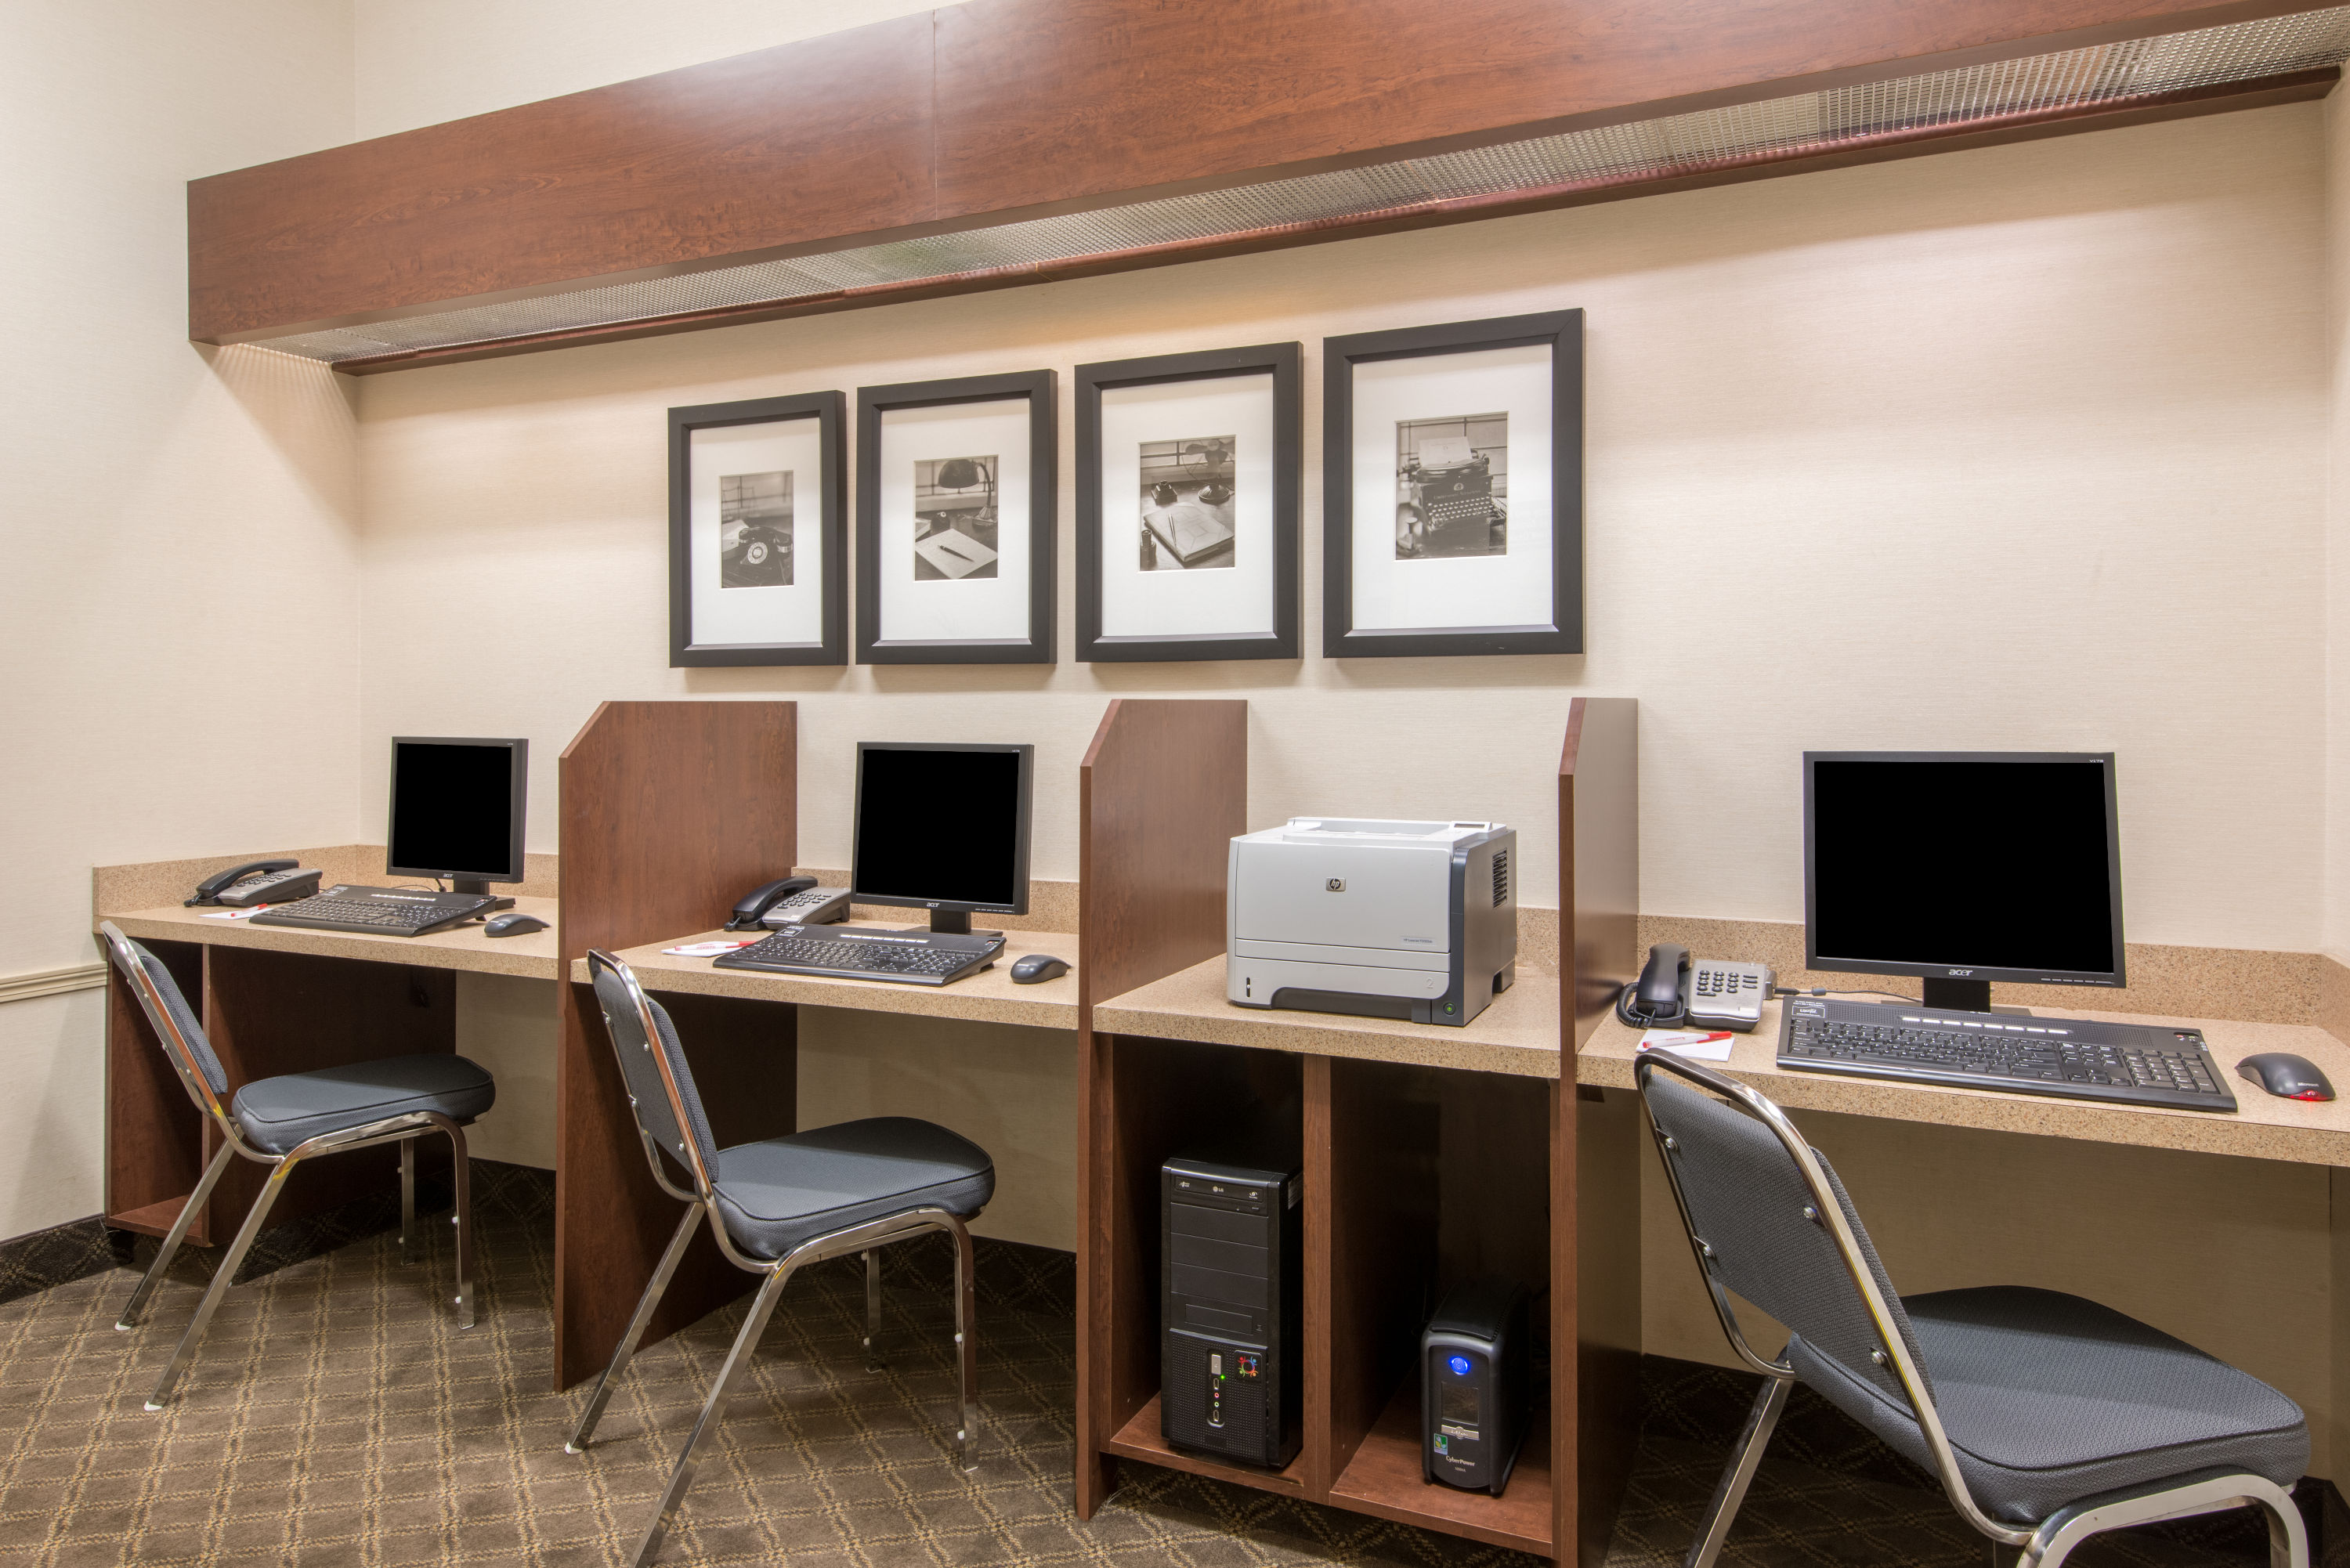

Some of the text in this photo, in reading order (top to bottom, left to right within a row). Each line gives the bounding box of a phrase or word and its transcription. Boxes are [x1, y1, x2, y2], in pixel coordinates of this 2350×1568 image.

[1330, 878, 1340, 890] hp
[1426, 977, 1434, 989] 2
[1445, 1455, 1475, 1466] CyberPower
